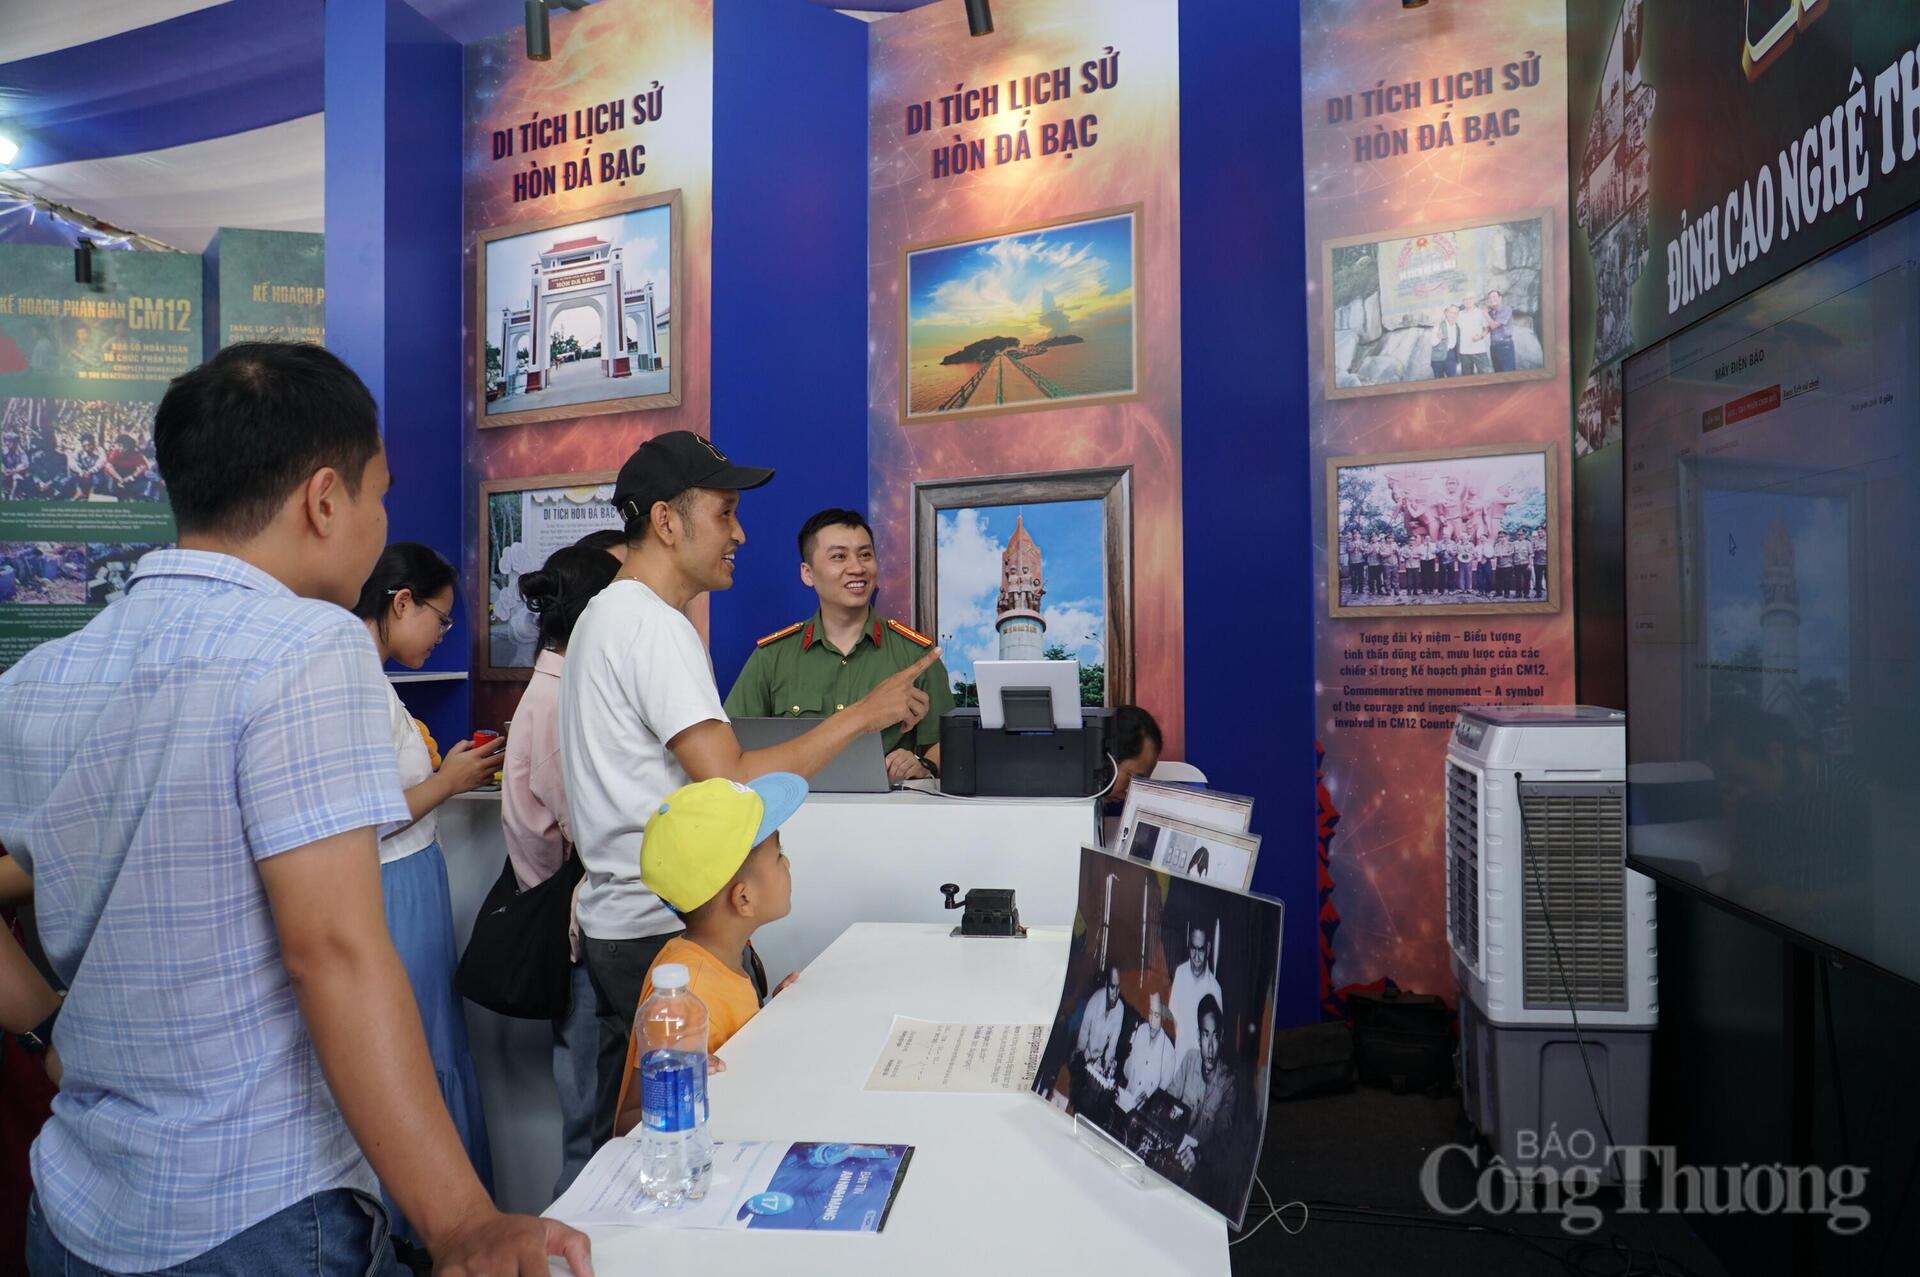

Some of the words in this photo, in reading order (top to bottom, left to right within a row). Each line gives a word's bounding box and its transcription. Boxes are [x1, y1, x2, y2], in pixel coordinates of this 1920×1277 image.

[906, 100, 931, 136] DI
[939, 82, 999, 127] TÍCH
[1008, 66, 1071, 114] LỊCH
[1081, 46, 1120, 94] SỬ
[1326, 95, 1353, 124] DI
[1360, 80, 1421, 117] TÍCH
[1429, 67, 1493, 108] LỊCH
[1501, 50, 1542, 91] SỬ
[492, 127, 513, 160] DI
[519, 112, 567, 153] TÍCH
[575, 99, 625, 144] LỊCH
[632, 80, 664, 125] SỬ
[932, 134, 985, 179] HÒN
[995, 119, 1031, 165] ĐÁ
[1041, 114, 1098, 159] BẠC
[1354, 124, 1408, 162] HÒN
[1417, 112, 1454, 151] ĐÁ
[1464, 108, 1520, 146] BẠC
[513, 161, 556, 202] HÒN
[563, 147, 592, 191] ĐÁ
[600, 144, 646, 186] BẠC
[1667, 205, 1720, 314] ĐỈNH
[1724, 165, 1774, 275] CAO
[1779, 66, 1869, 241] NGHỆ
[128, 296, 192, 332] CM12
[543, 508, 551, 520] DI
[553, 506, 569, 520] TÍCH
[600, 507, 616, 521] BẠC
[1360, 632, 1390, 645] Tượng
[1392, 631, 1407, 643] đài
[1425, 632, 1451, 645] niệm
[1463, 629, 1487, 642] Biểu
[1490, 631, 1521, 644] tượng
[1344, 649, 1364, 660] tinh
[1366, 648, 1388, 660] thần
[1391, 649, 1417, 661] dũng
[1472, 648, 1495, 661] lược
[1498, 646, 1517, 658] của
[1521, 647, 1540, 658] các
[1339, 664, 1366, 676] chiến
[1380, 666, 1408, 678] trong
[1411, 664, 1424, 676] Kế
[1427, 665, 1458, 678] hoạch
[1460, 664, 1487, 678] phản
[1490, 664, 1513, 678] gián
[1516, 664, 1548, 677] CM12.
[1343, 685, 1424, 697] Commemorative
[1427, 686, 1481, 697] monument
[1494, 686, 1502, 696] A
[1505, 686, 1544, 698] symbol
[1332, 702, 1342, 712] of
[1345, 702, 1361, 712] the
[1364, 703, 1403, 714] courage
[1407, 702, 1425, 712] and
[1335, 719, 1375, 729] involved
[1377, 719, 1387, 729] in
[1390, 719, 1417, 729] CM12
[761, 1195, 780, 1210] 17
